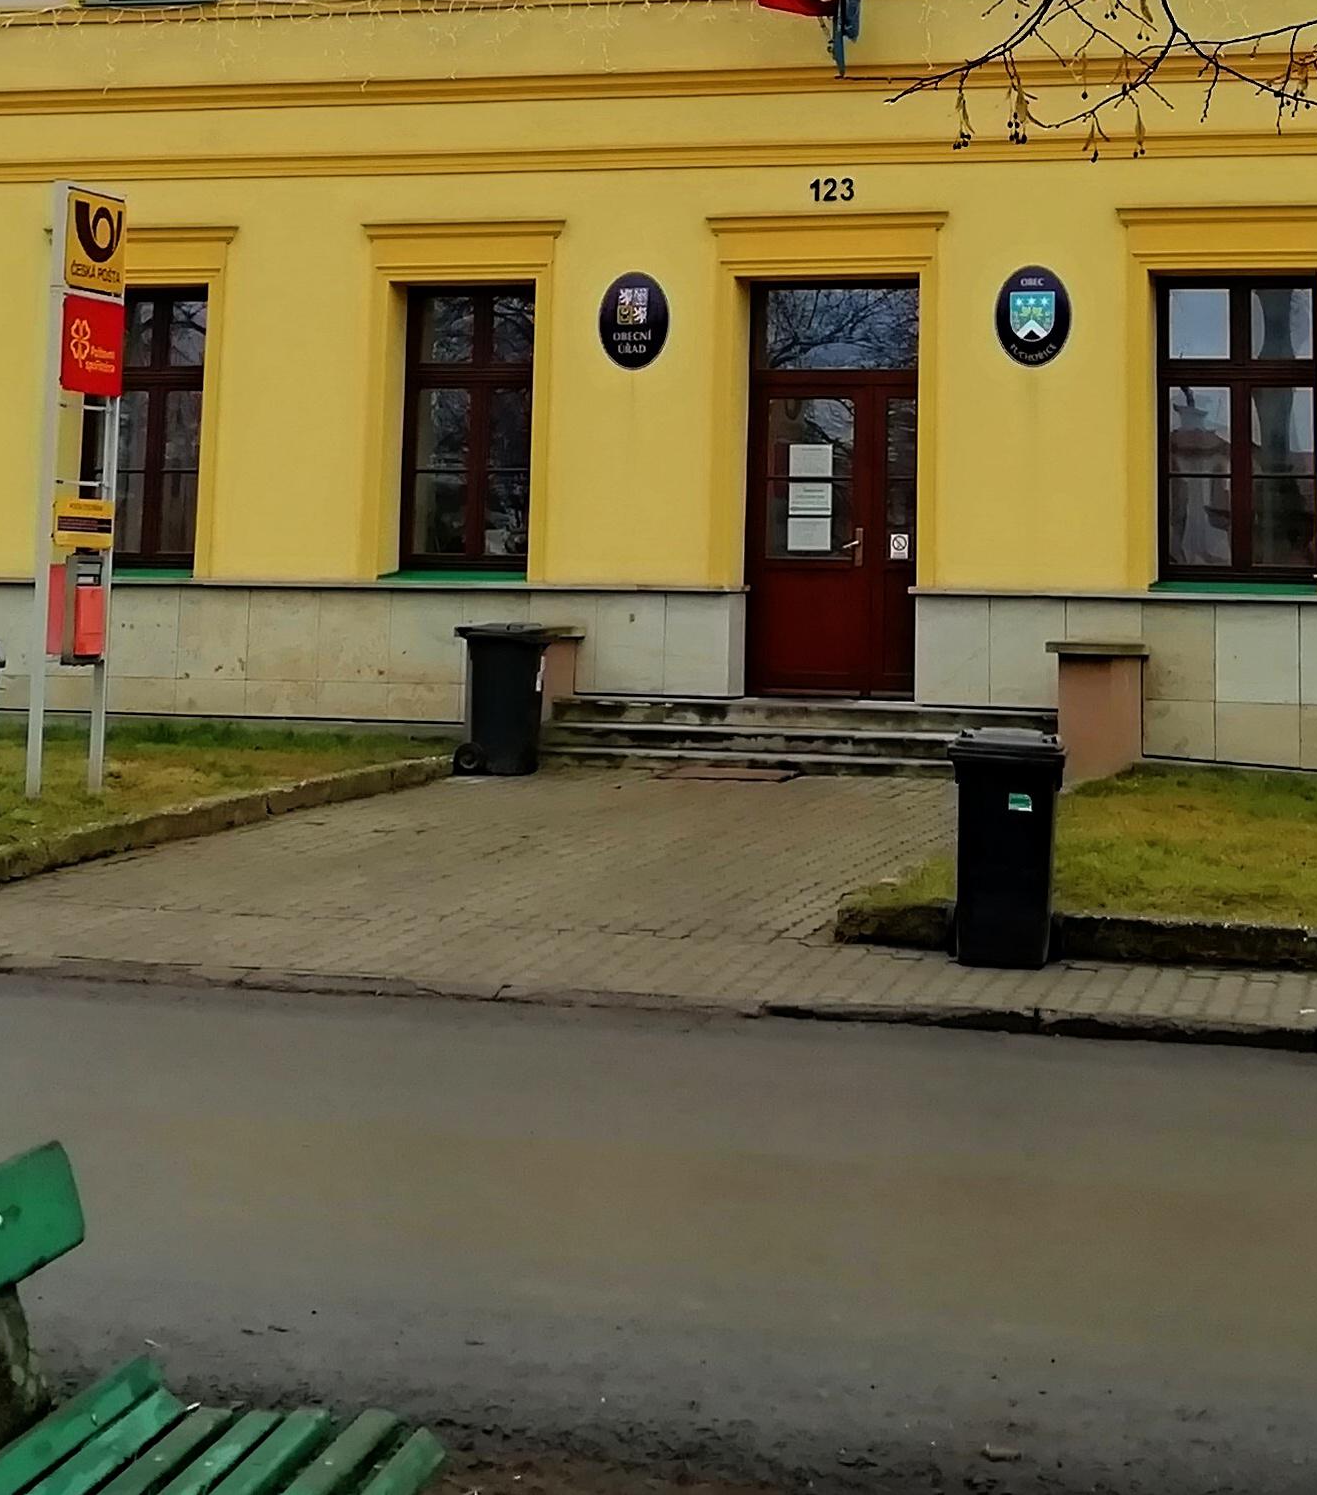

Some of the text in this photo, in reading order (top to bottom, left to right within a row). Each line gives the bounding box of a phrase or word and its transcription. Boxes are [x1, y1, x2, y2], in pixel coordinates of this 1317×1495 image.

[810, 177, 854, 202] 123
[71, 259, 121, 284] ČESKÁ POŠTA
[1020, 277, 1045, 287] OBEC
[612, 329, 652, 341] OBECNÍ
[617, 342, 647, 354] ÚŘAD
